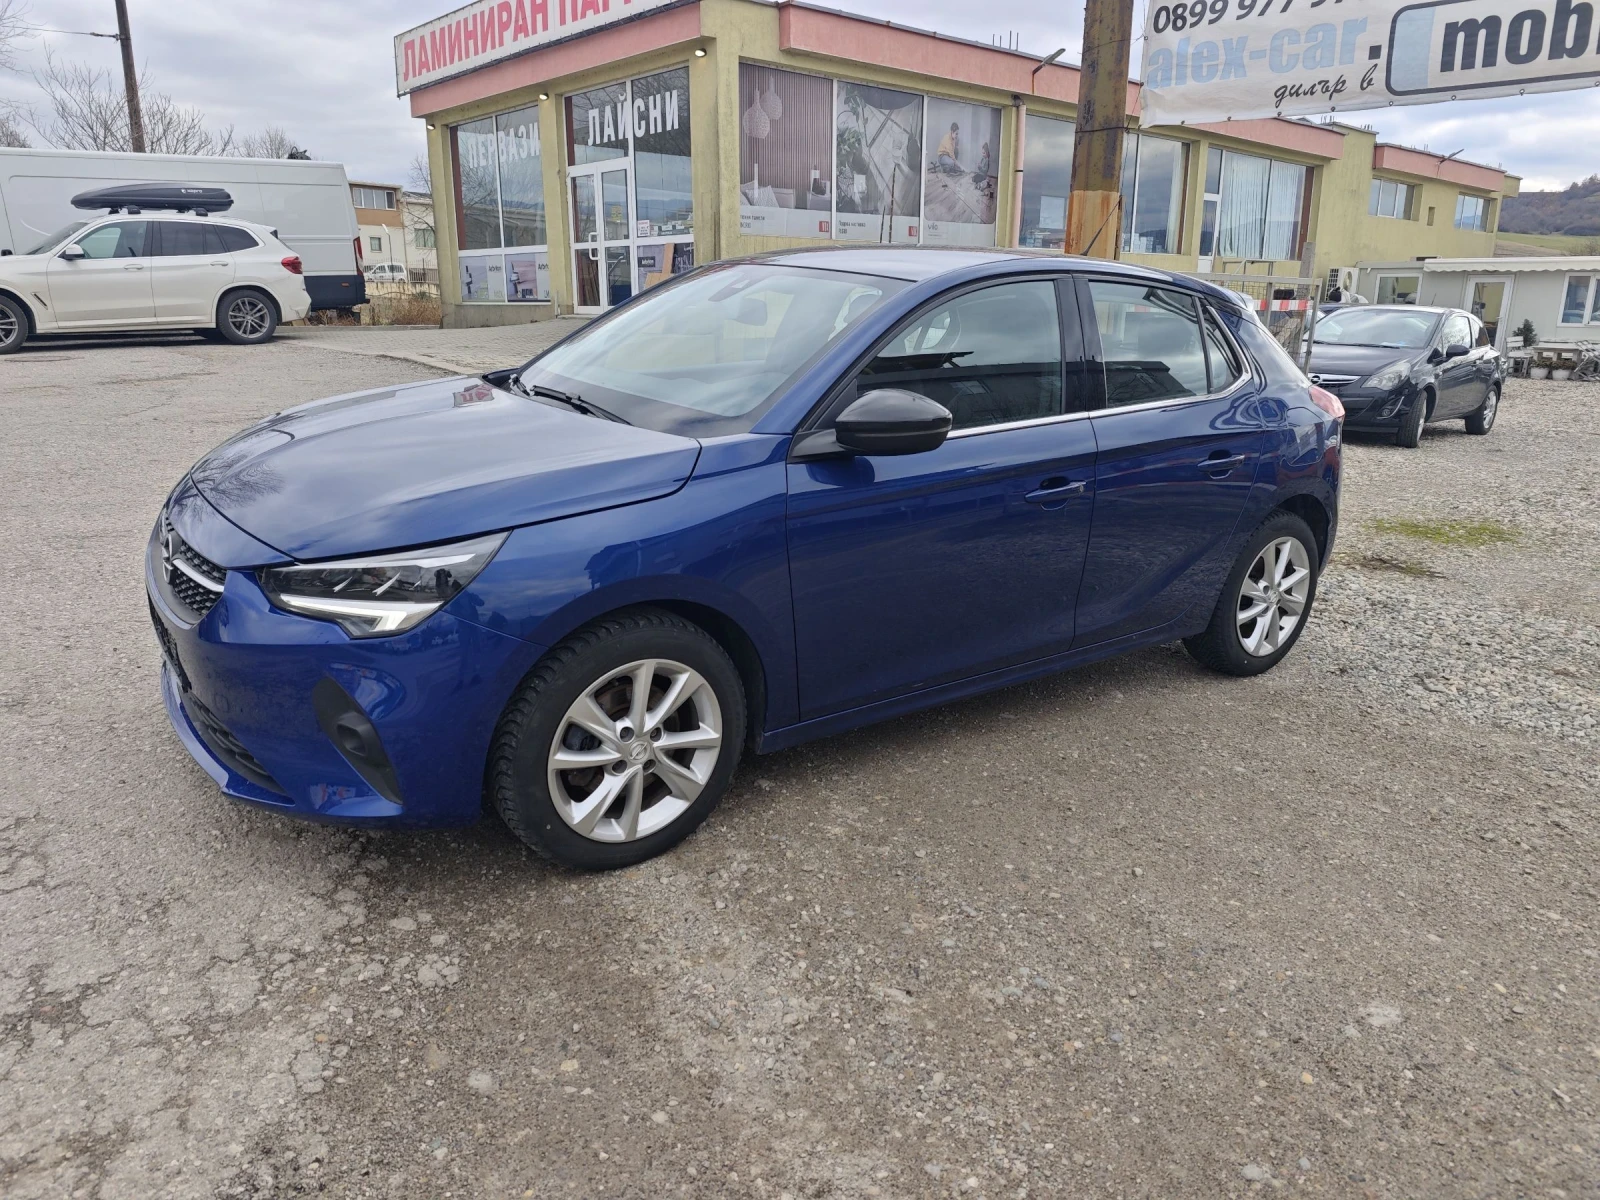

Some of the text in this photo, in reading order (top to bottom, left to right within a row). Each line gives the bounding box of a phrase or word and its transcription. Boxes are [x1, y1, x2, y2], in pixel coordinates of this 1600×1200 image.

[402, 0, 549, 82] ЛАМИНИРАН
[1153, 0, 1227, 34] 0899
[1439, 0, 1600, 73] mob
[587, 89, 679, 146] ЛАЙСНИ
[1274, 77, 1348, 110] дилър
[467, 121, 540, 169] ПЕРВАЗИ
